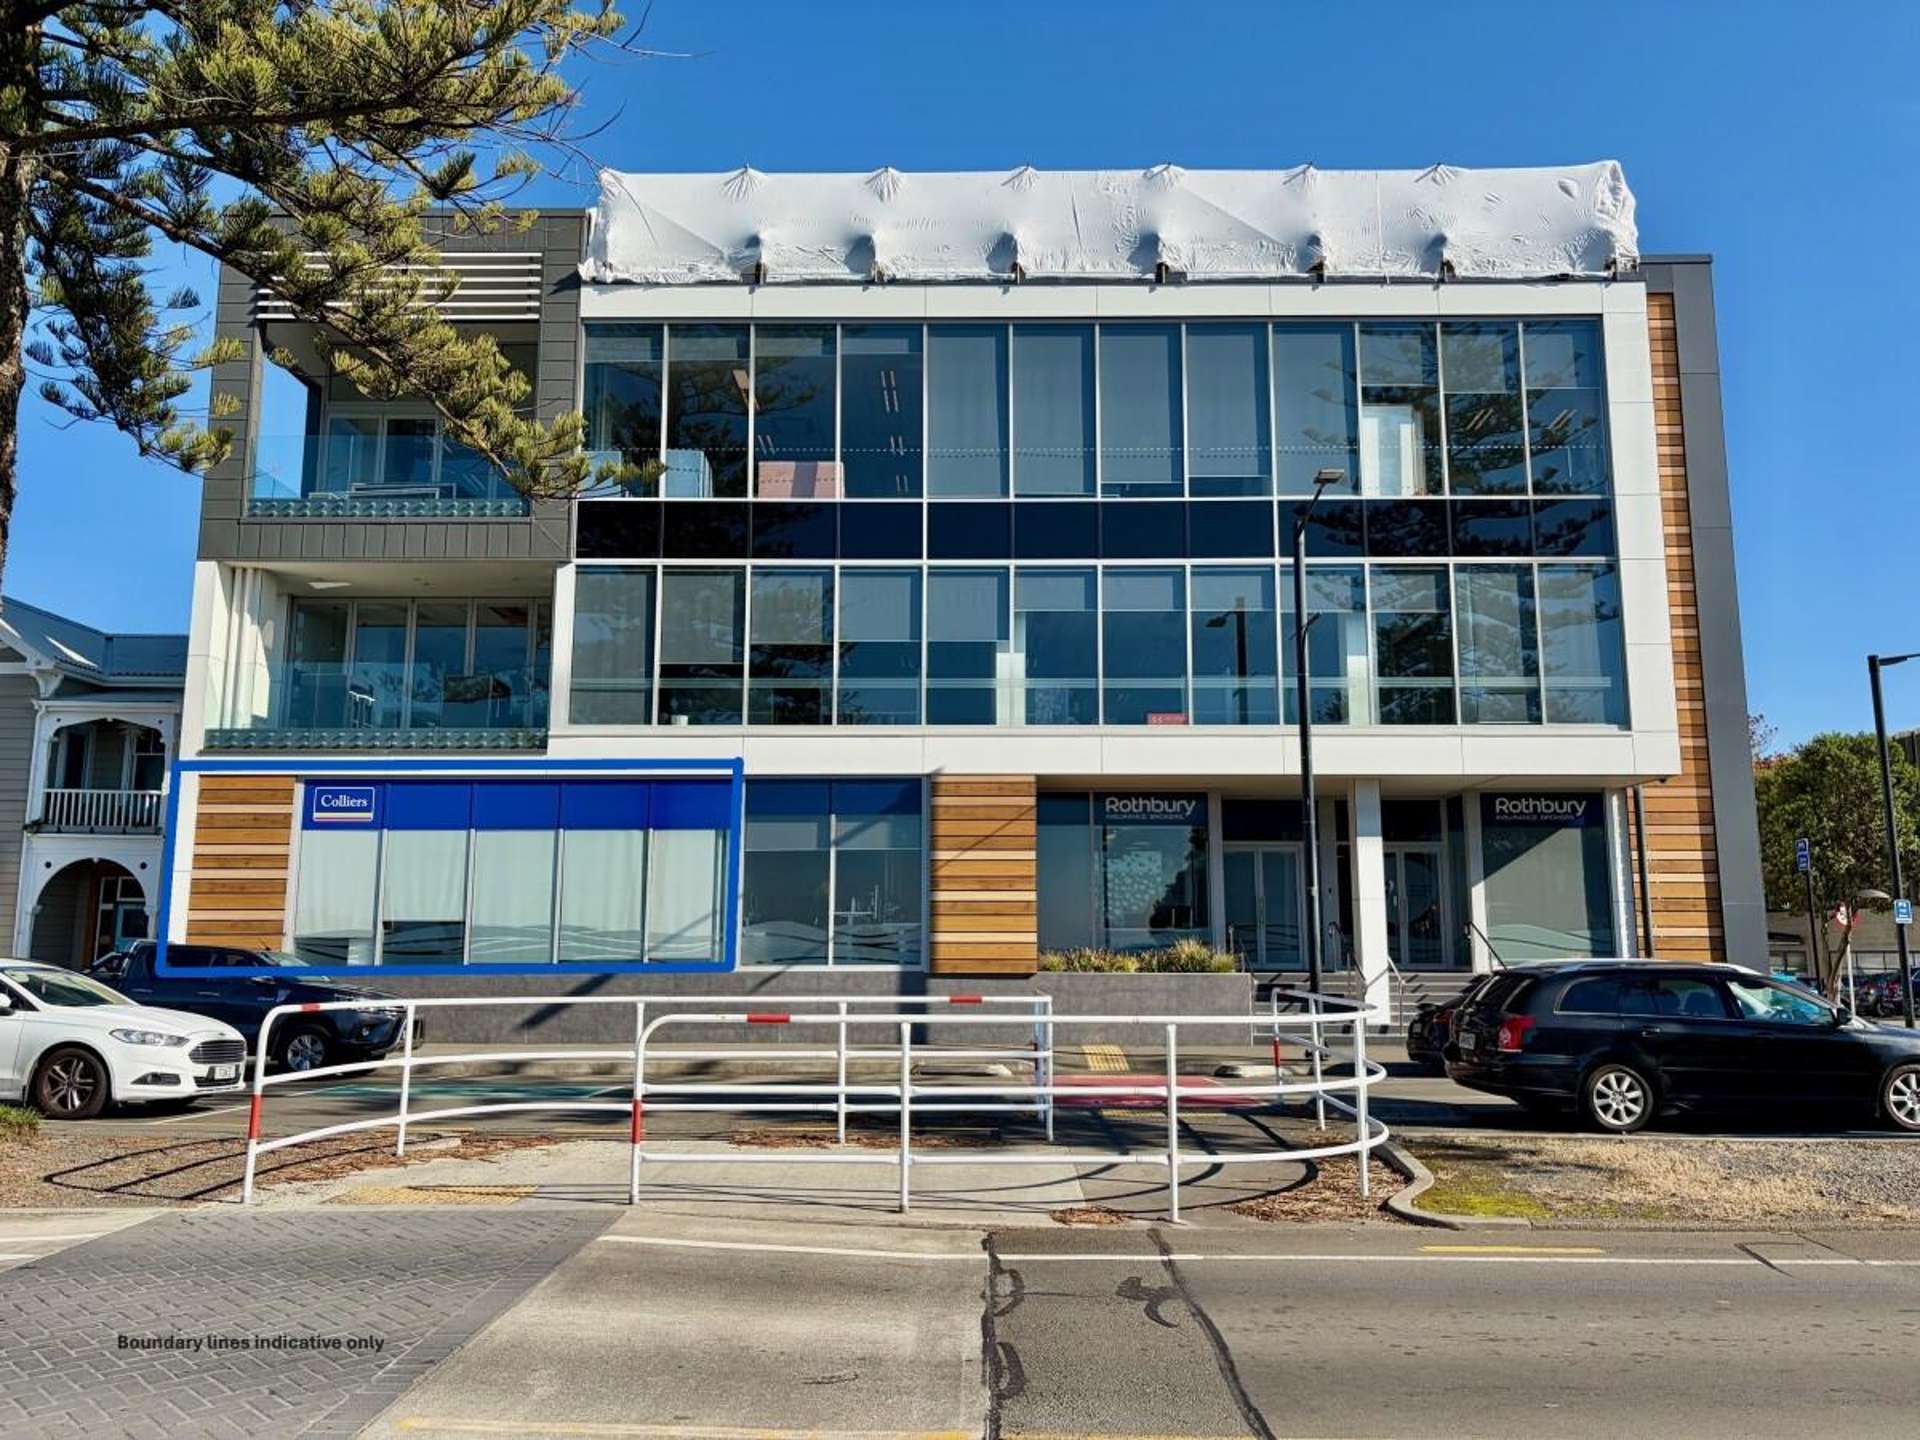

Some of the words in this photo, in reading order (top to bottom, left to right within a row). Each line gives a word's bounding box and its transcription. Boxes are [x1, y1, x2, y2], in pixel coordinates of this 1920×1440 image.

[320, 794, 369, 807] Colliers
[1105, 797, 1196, 816] Rothbury
[1496, 798, 1587, 816] Rothbury
